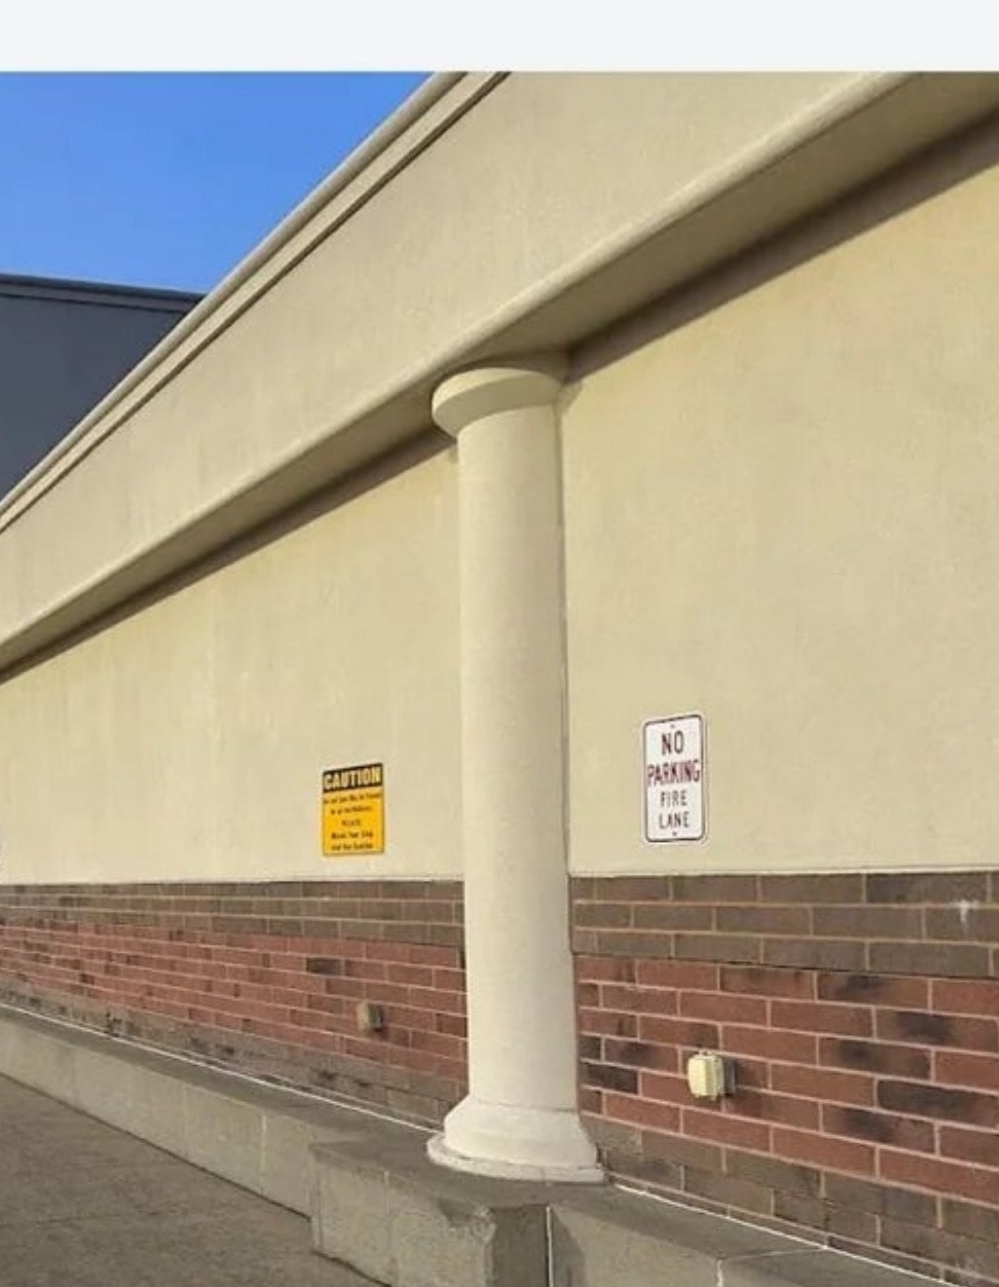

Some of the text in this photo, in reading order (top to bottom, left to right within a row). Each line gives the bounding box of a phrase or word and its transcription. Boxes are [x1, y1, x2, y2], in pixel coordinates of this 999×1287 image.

[661, 730, 684, 756] NO
[324, 766, 381, 790] CAUTION
[647, 758, 701, 787] PARKING
[660, 790, 687, 808] FIRE
[658, 811, 689, 830] LANE
